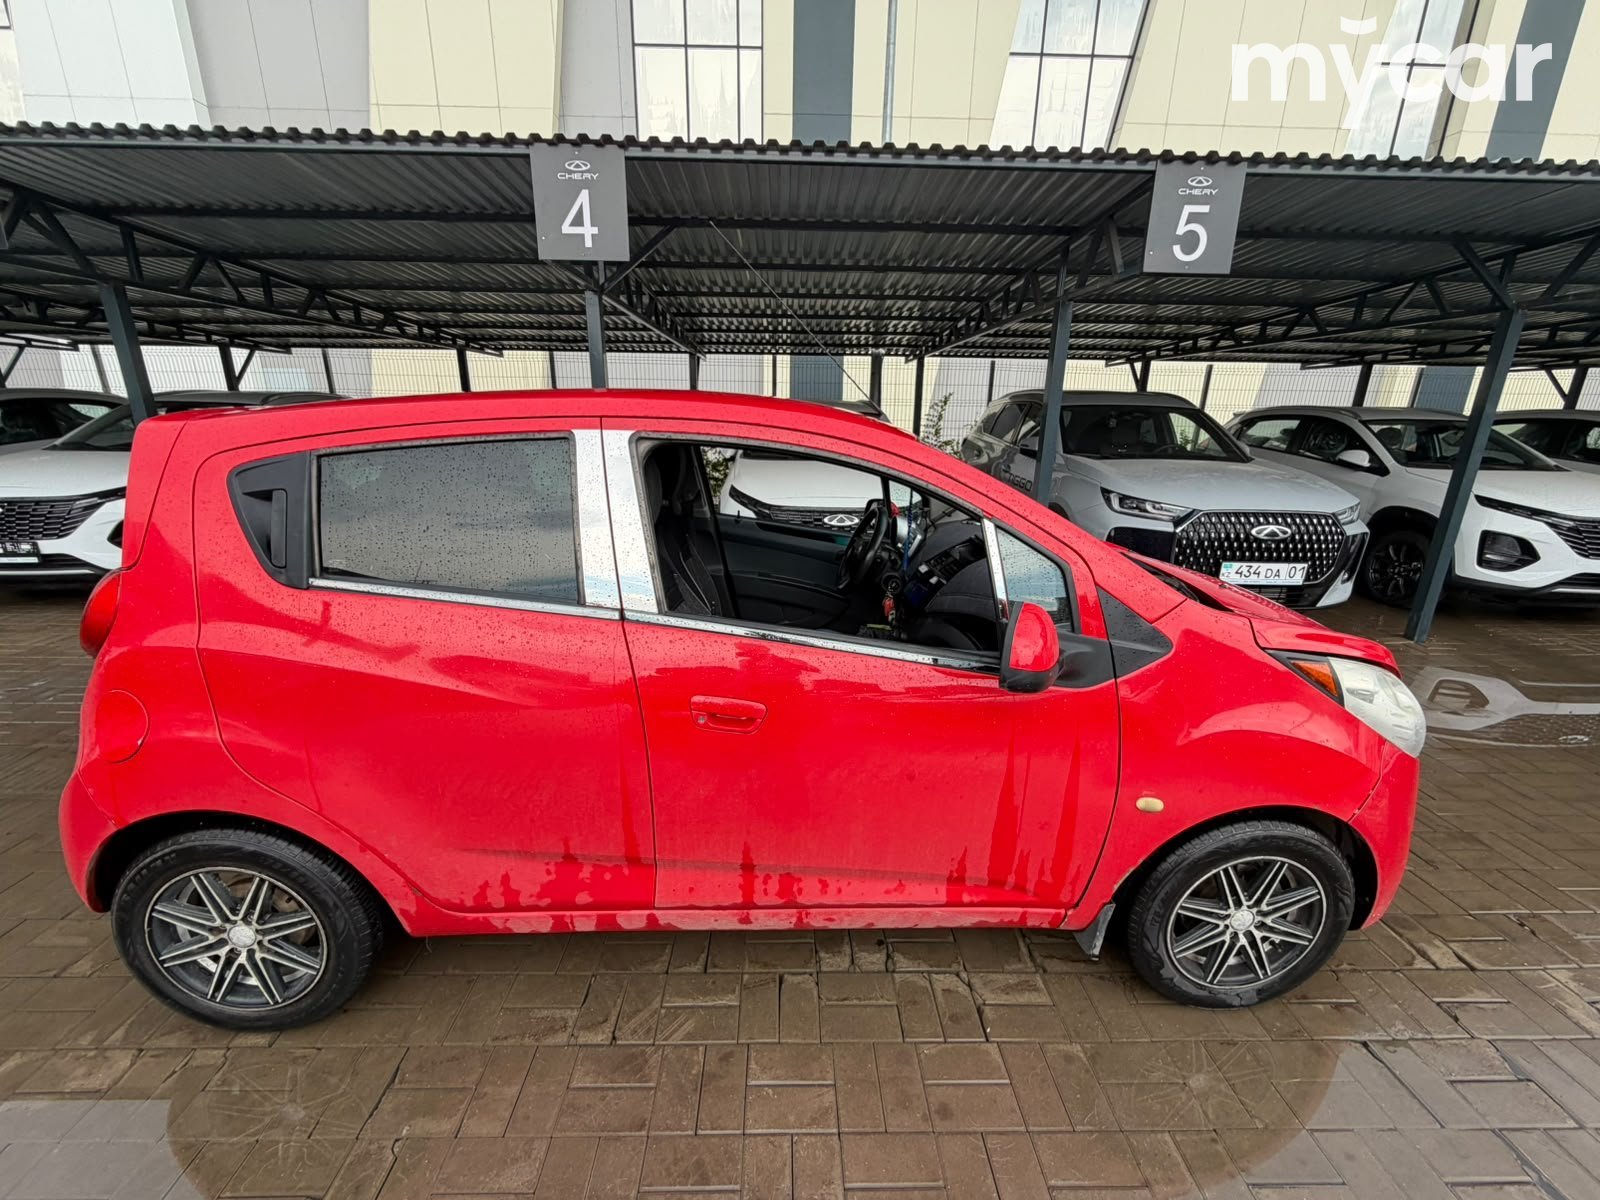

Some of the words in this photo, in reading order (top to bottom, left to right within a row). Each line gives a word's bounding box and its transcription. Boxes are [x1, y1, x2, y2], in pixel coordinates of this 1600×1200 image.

[557, 172, 599, 180] CHERY
[561, 189, 599, 248] 4
[1172, 204, 1210, 262] 5
[1235, 565, 1261, 578] 434
[1264, 568, 1281, 579] DA
[1288, 566, 1306, 579] 01
